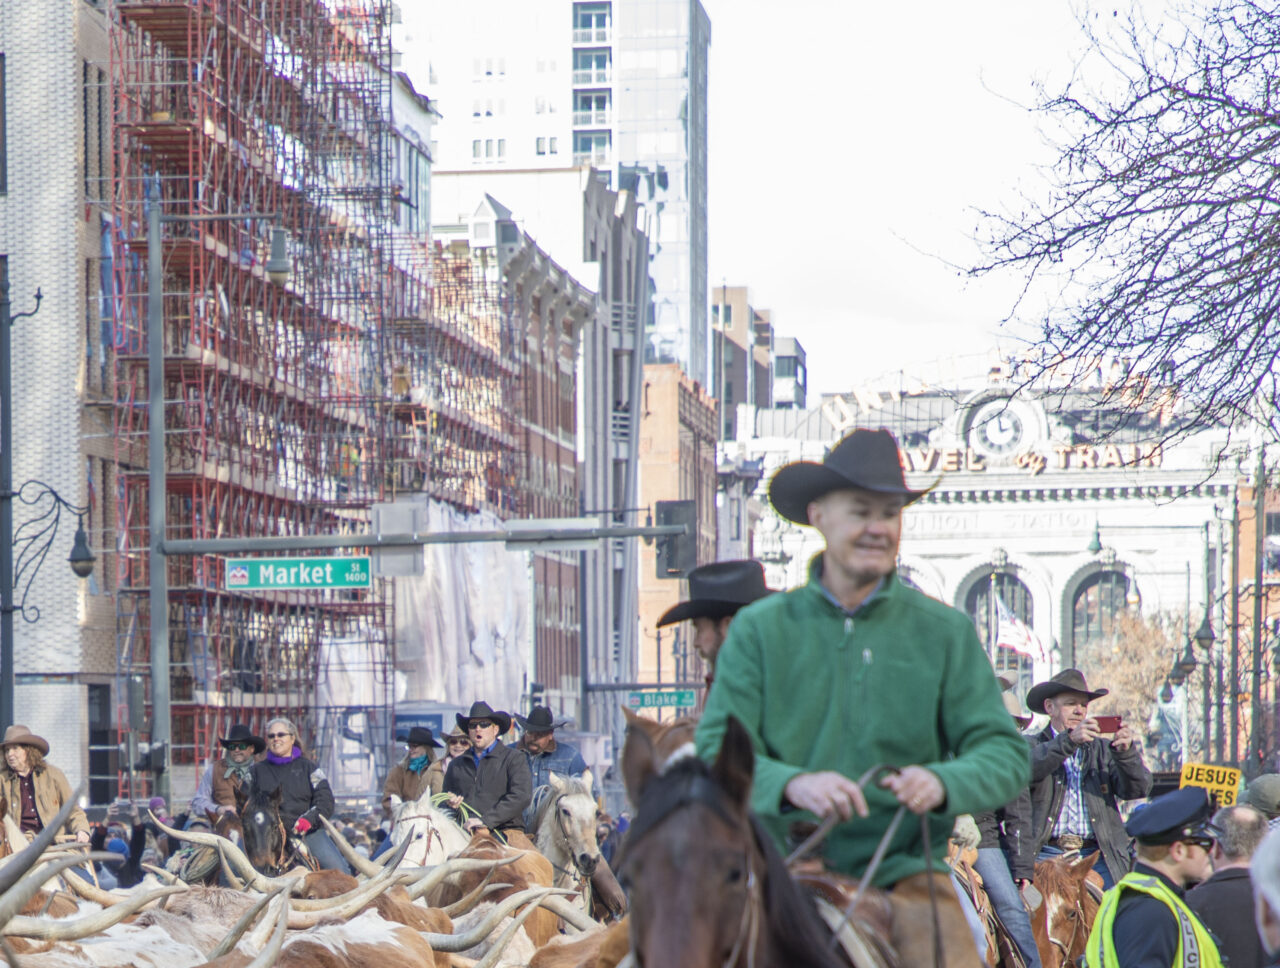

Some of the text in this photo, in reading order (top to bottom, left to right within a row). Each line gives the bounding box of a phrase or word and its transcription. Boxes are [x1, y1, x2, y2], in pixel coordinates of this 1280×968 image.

[1053, 443, 1163, 469] TRAIN
[259, 562, 333, 585] Market
[345, 573, 367, 582] 1400
[644, 693, 678, 705] Blake
[1185, 766, 1237, 787] JESUS
